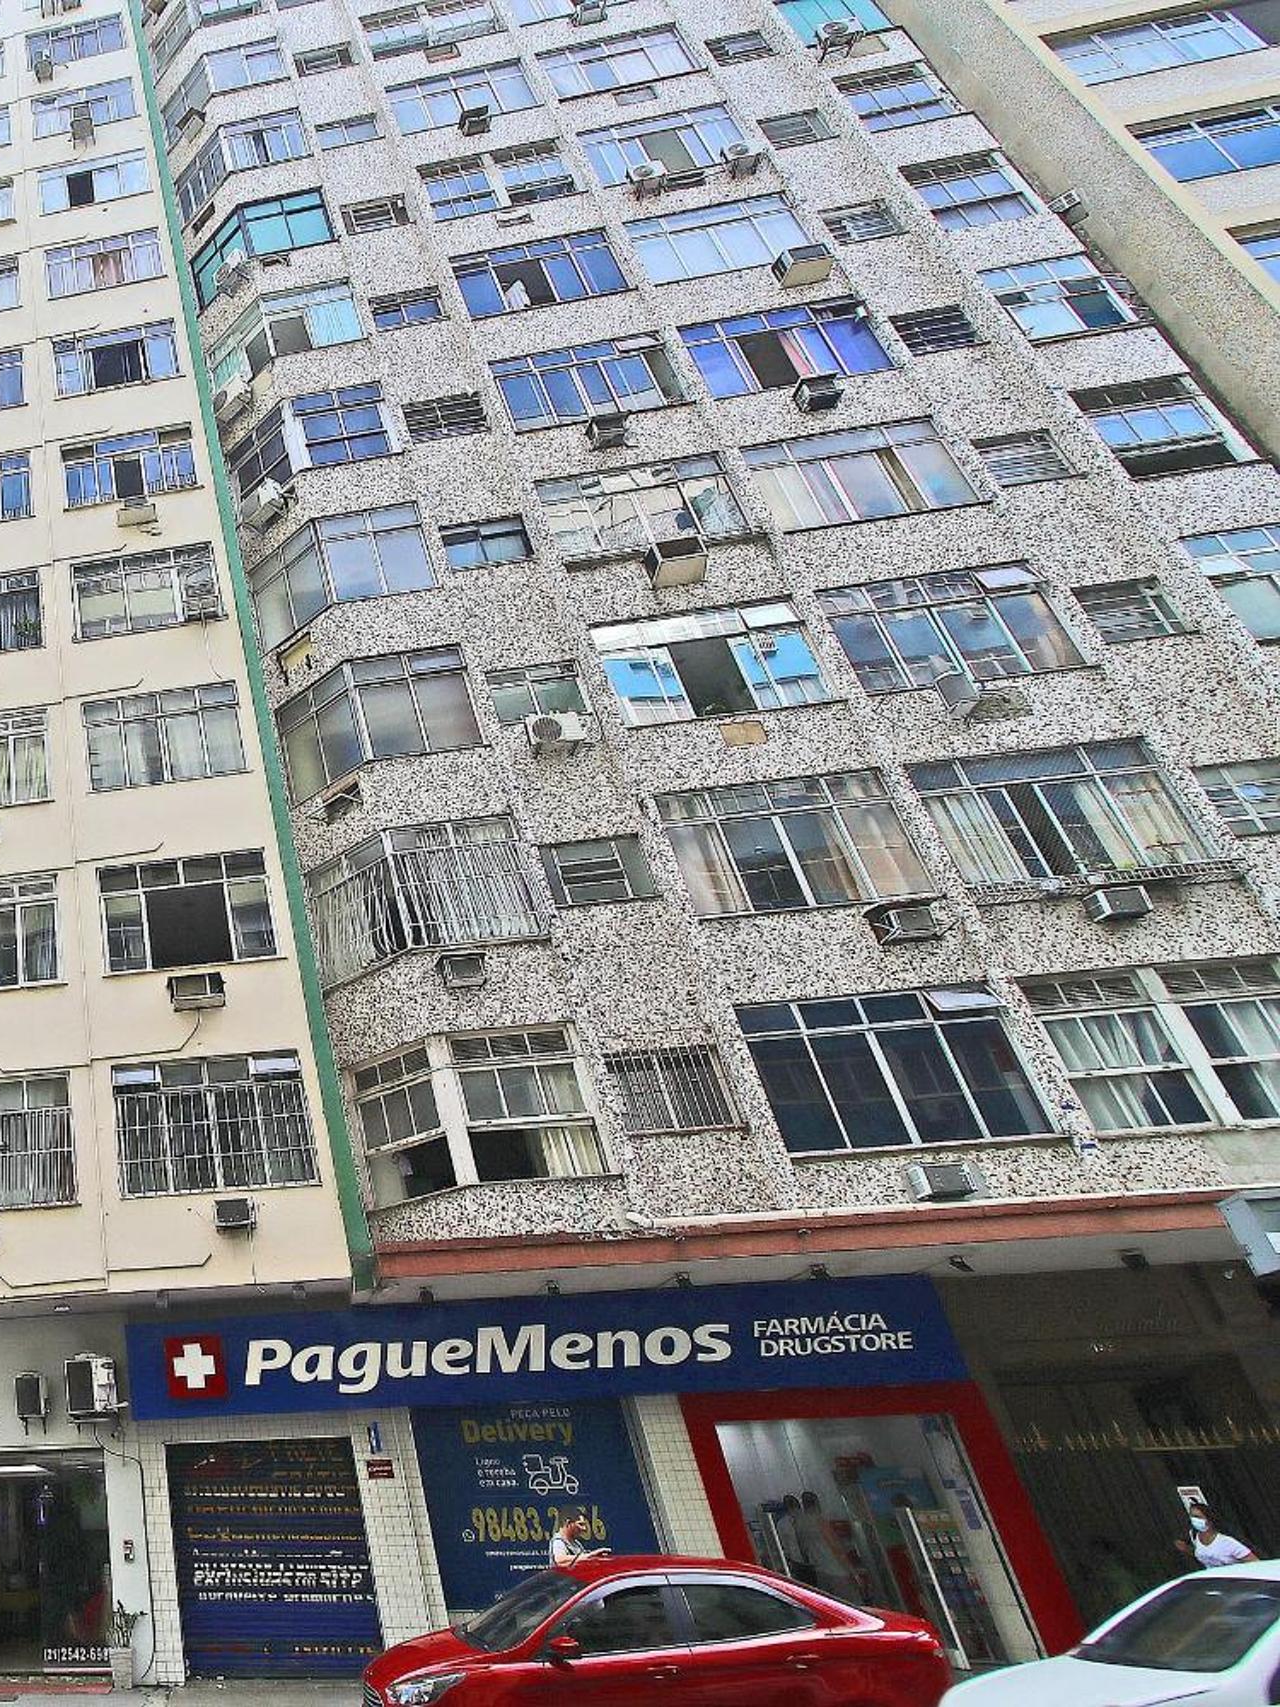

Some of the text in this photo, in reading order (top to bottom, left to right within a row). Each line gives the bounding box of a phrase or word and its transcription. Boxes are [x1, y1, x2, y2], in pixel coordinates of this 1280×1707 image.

[753, 1310, 888, 1338] FARMÁCIA
[760, 1331, 914, 1357] DRUGSTORE
[244, 1323, 732, 1394] PagueMenos
[542, 1408, 570, 1418] PELO
[462, 1420, 573, 1445] Delivery
[472, 1504, 607, 1542] 98483.26
